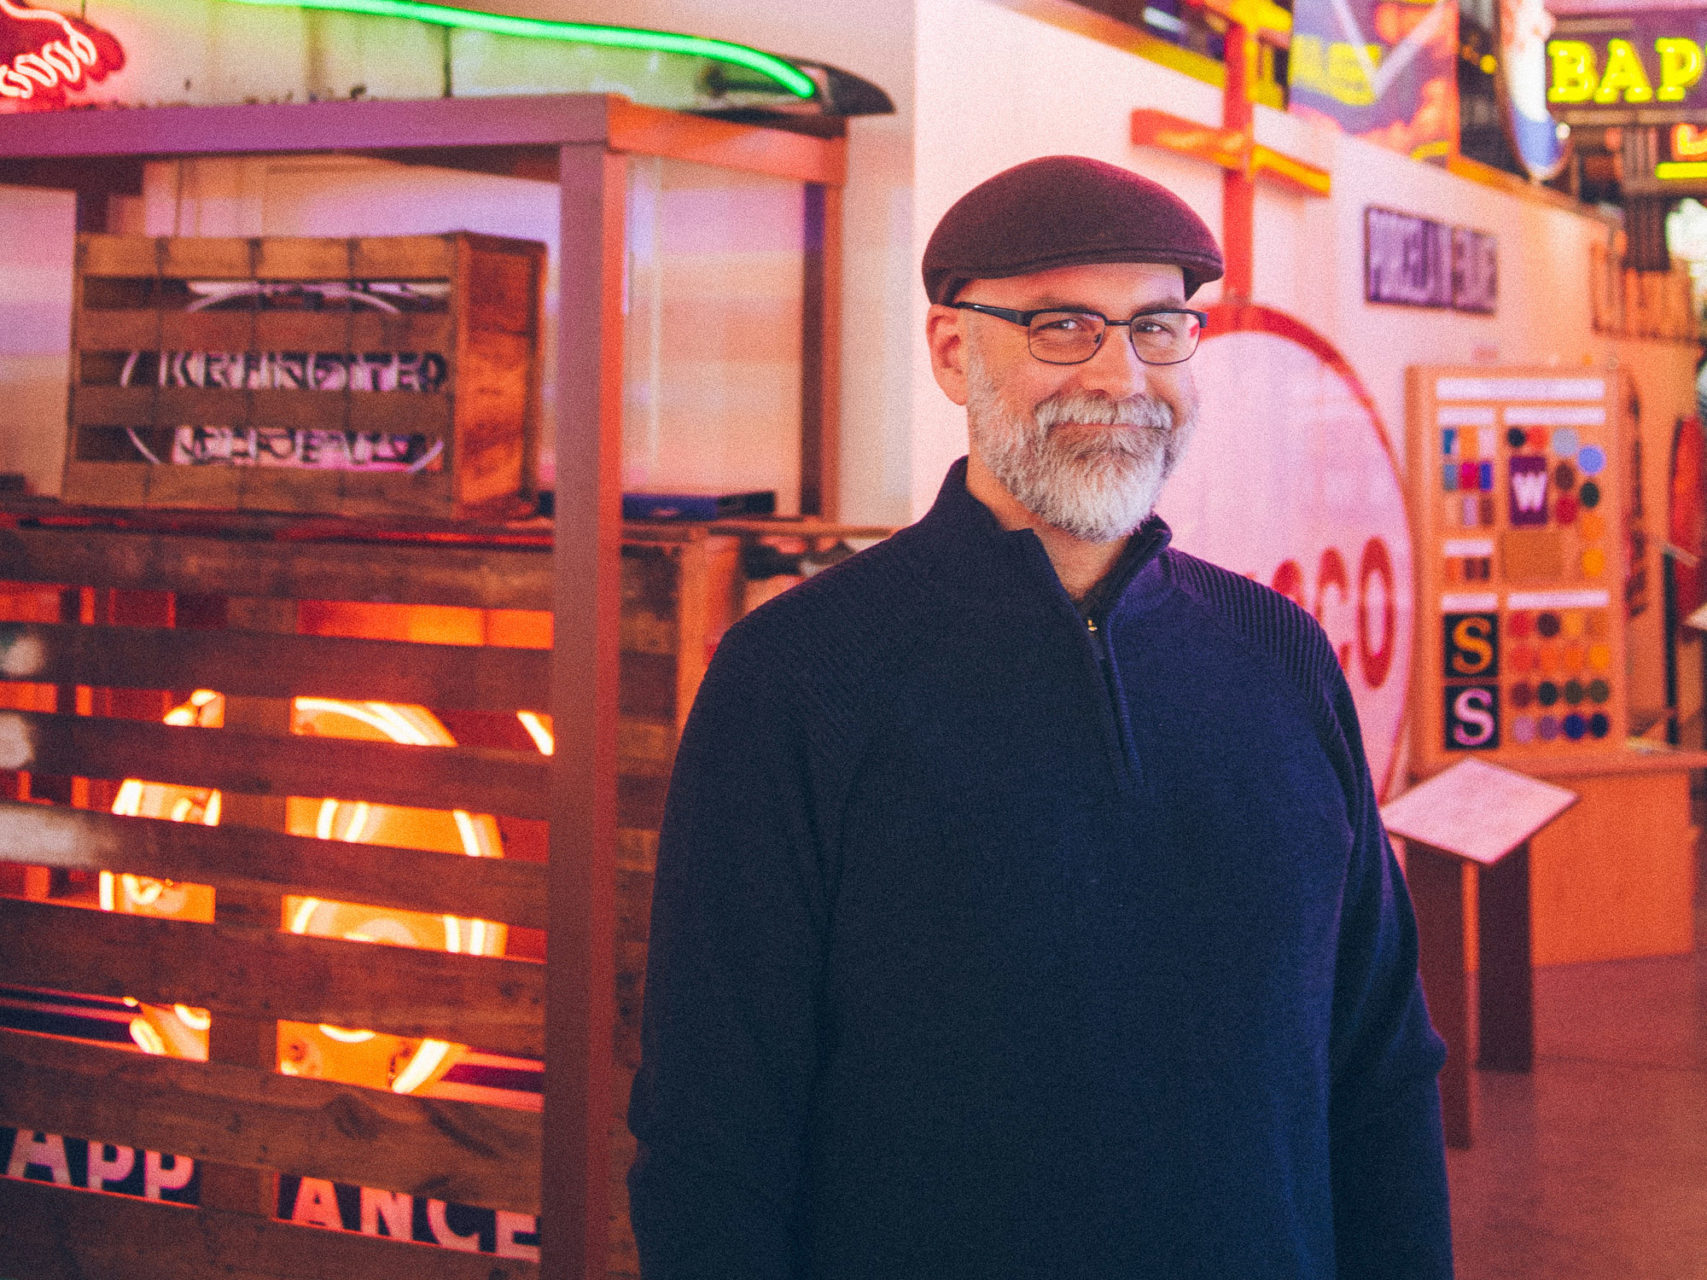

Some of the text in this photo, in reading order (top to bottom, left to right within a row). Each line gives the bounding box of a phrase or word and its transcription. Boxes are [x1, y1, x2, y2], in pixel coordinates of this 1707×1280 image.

[1547, 37, 1707, 104] BAP
[1451, 617, 1494, 675] S
[1452, 687, 1496, 747] S
